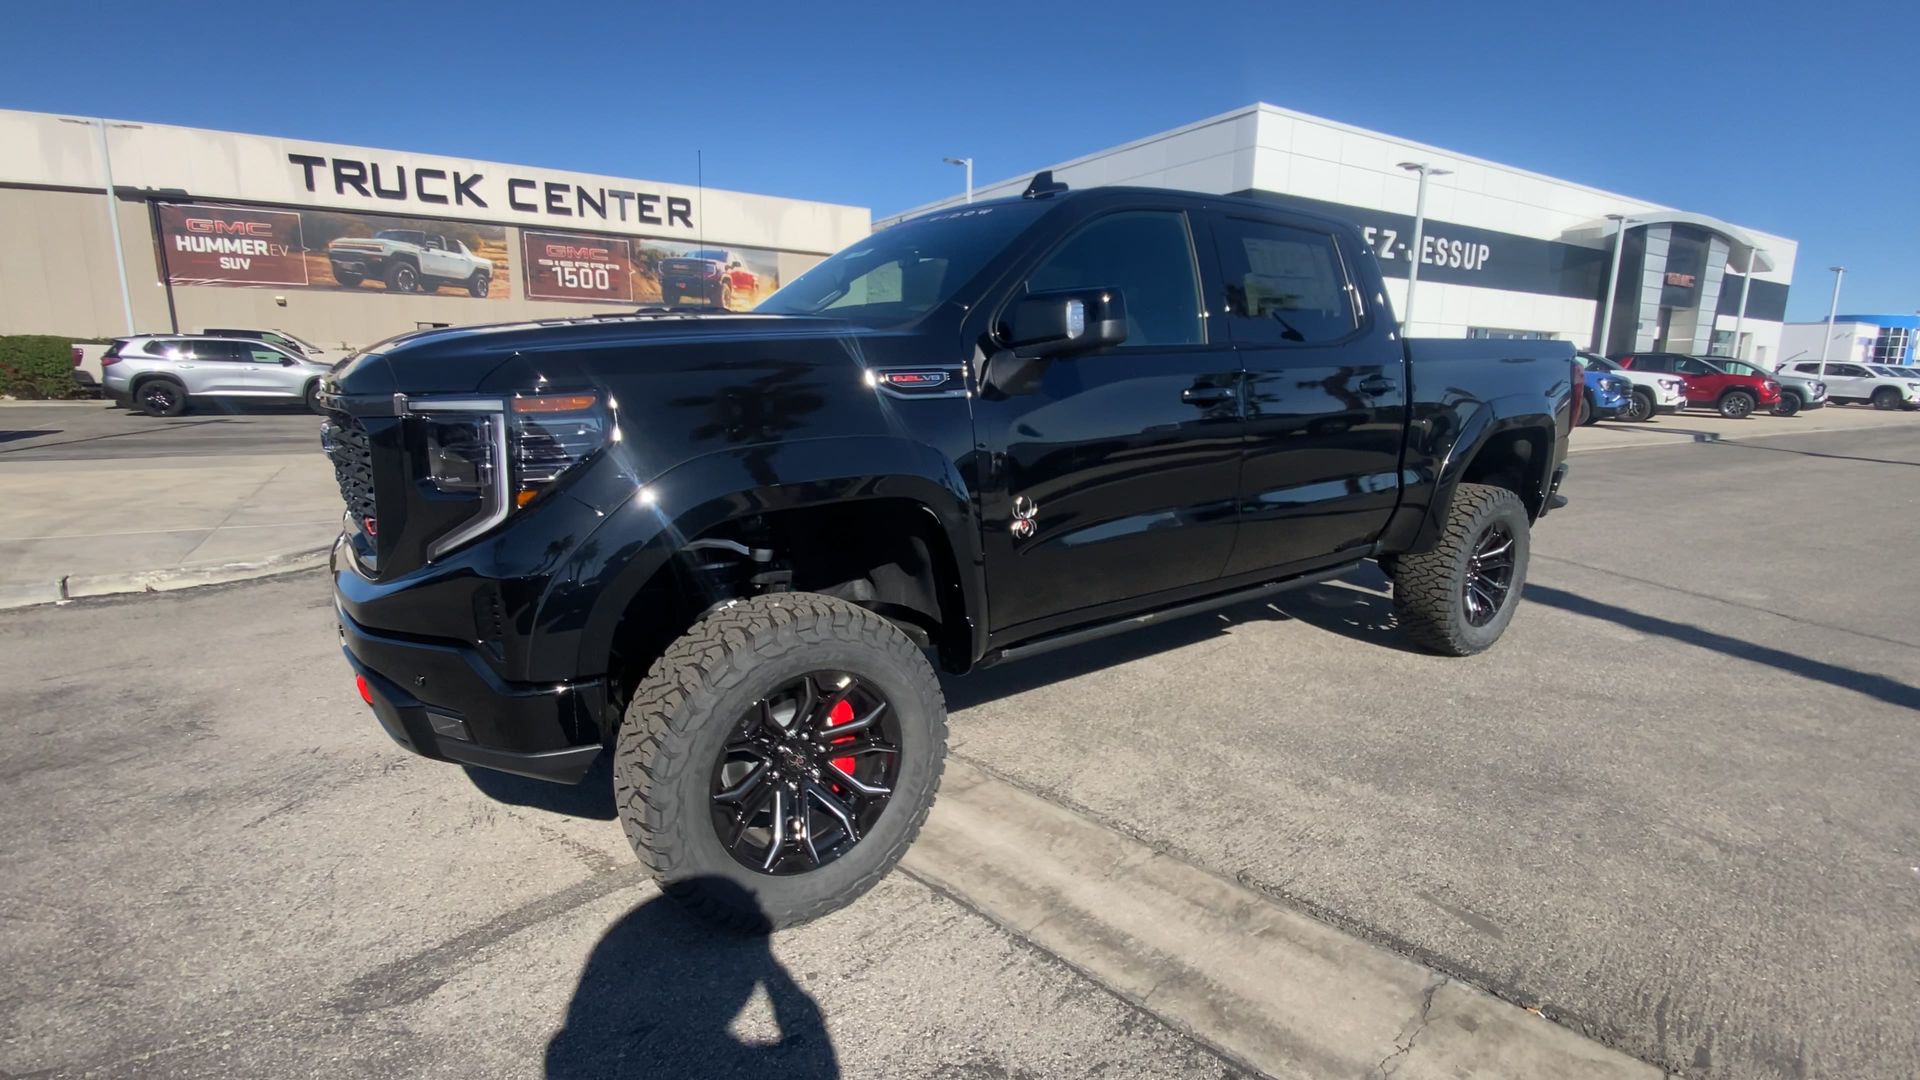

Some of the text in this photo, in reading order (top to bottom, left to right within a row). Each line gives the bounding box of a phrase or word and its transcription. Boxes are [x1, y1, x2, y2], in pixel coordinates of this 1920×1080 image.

[288, 153, 694, 229] TRUCK CENTER
[186, 218, 273, 237] GMC
[175, 235, 289, 257] HUMMER EV
[546, 244, 609, 261] GMC
[219, 257, 251, 270] SUV
[551, 266, 609, 290] 1500
